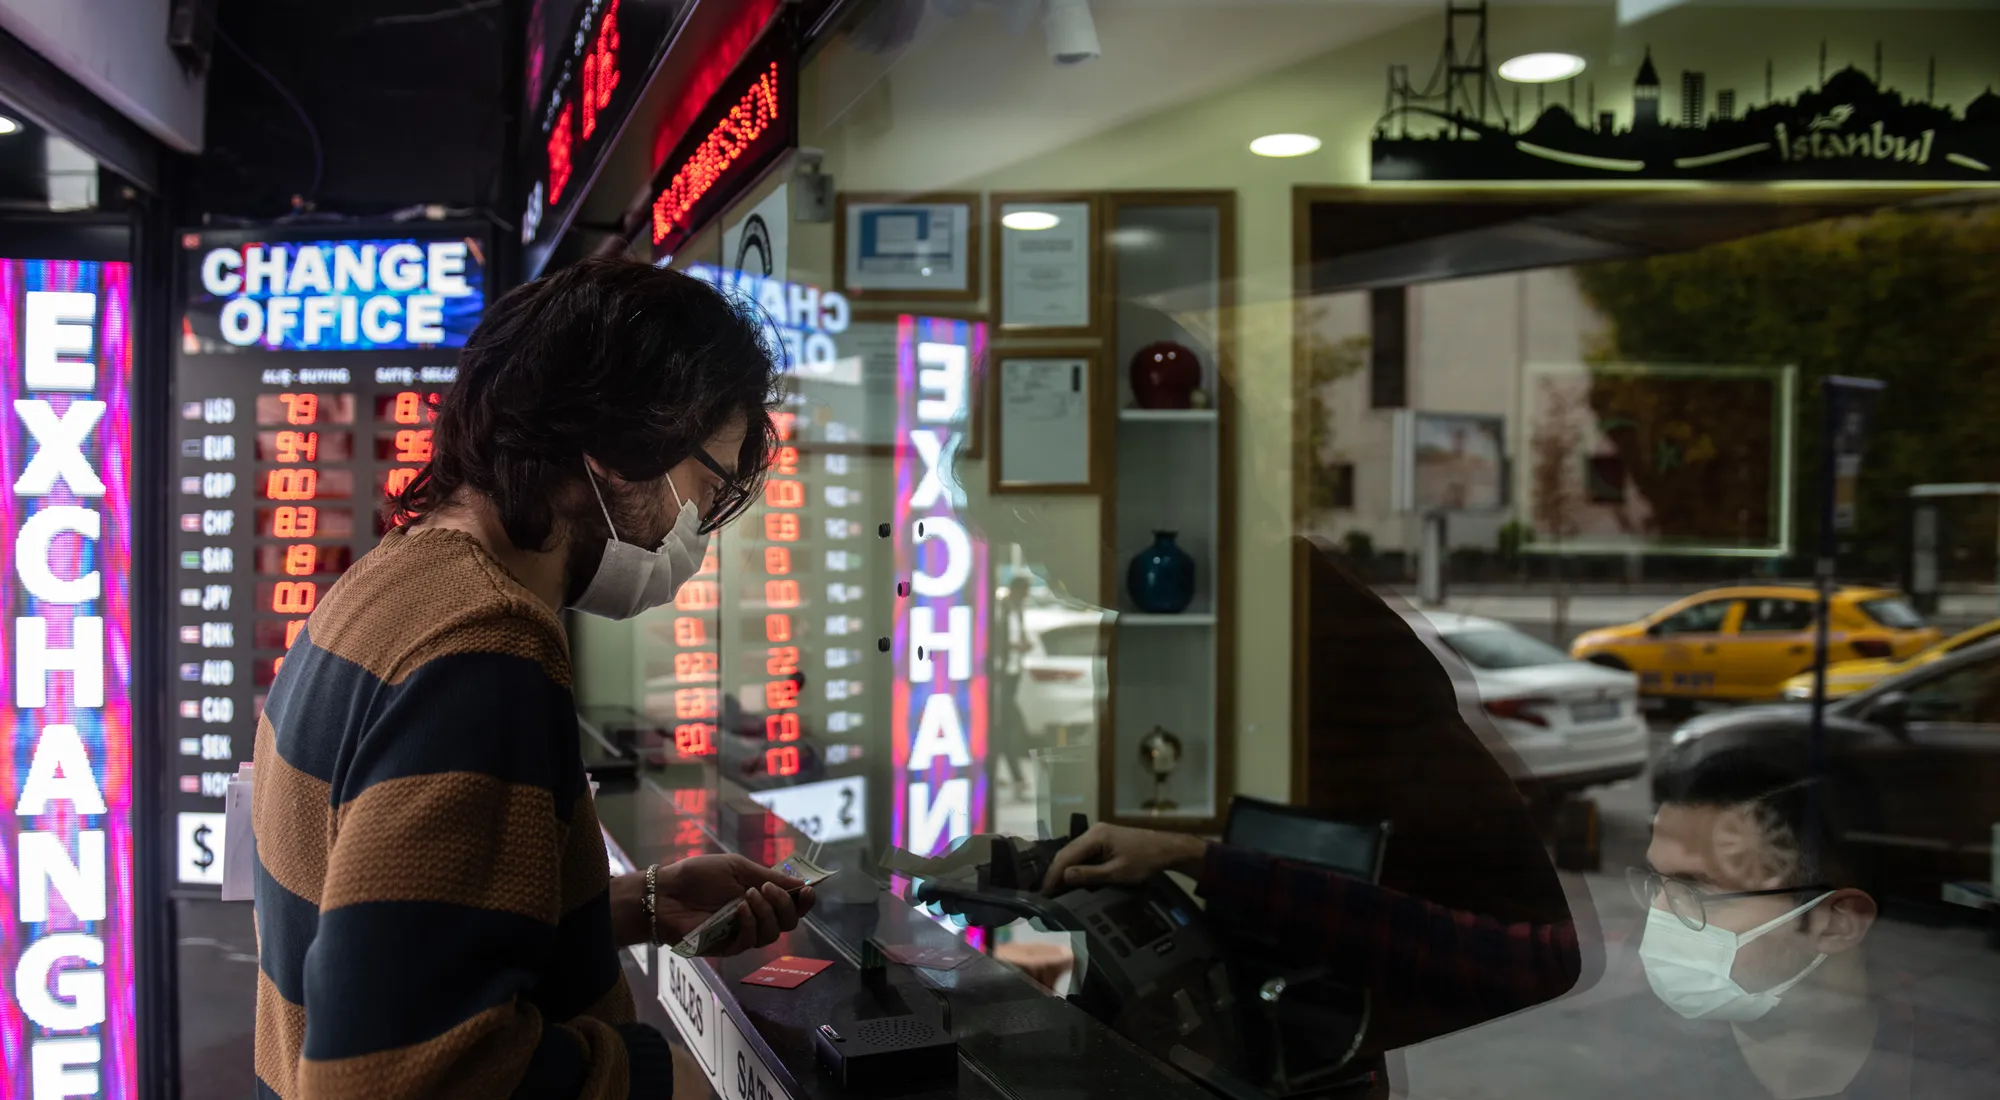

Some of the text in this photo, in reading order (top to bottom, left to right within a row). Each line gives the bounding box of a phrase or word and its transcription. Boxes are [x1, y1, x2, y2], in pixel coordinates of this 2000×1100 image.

[202, 242, 473, 297] CHANGE
[220, 294, 446, 347] OFFICE
[204, 397, 236, 424] USD
[203, 434, 236, 462] EUR
[203, 471, 237, 499] GBP
[202, 508, 235, 537] CHF
[202, 546, 234, 574] SAR
[201, 583, 233, 611] JPY
[201, 658, 235, 686] AUD
[201, 695, 235, 724] CAD
[201, 733, 233, 761] SEK
[669, 957, 704, 1037] SALES
